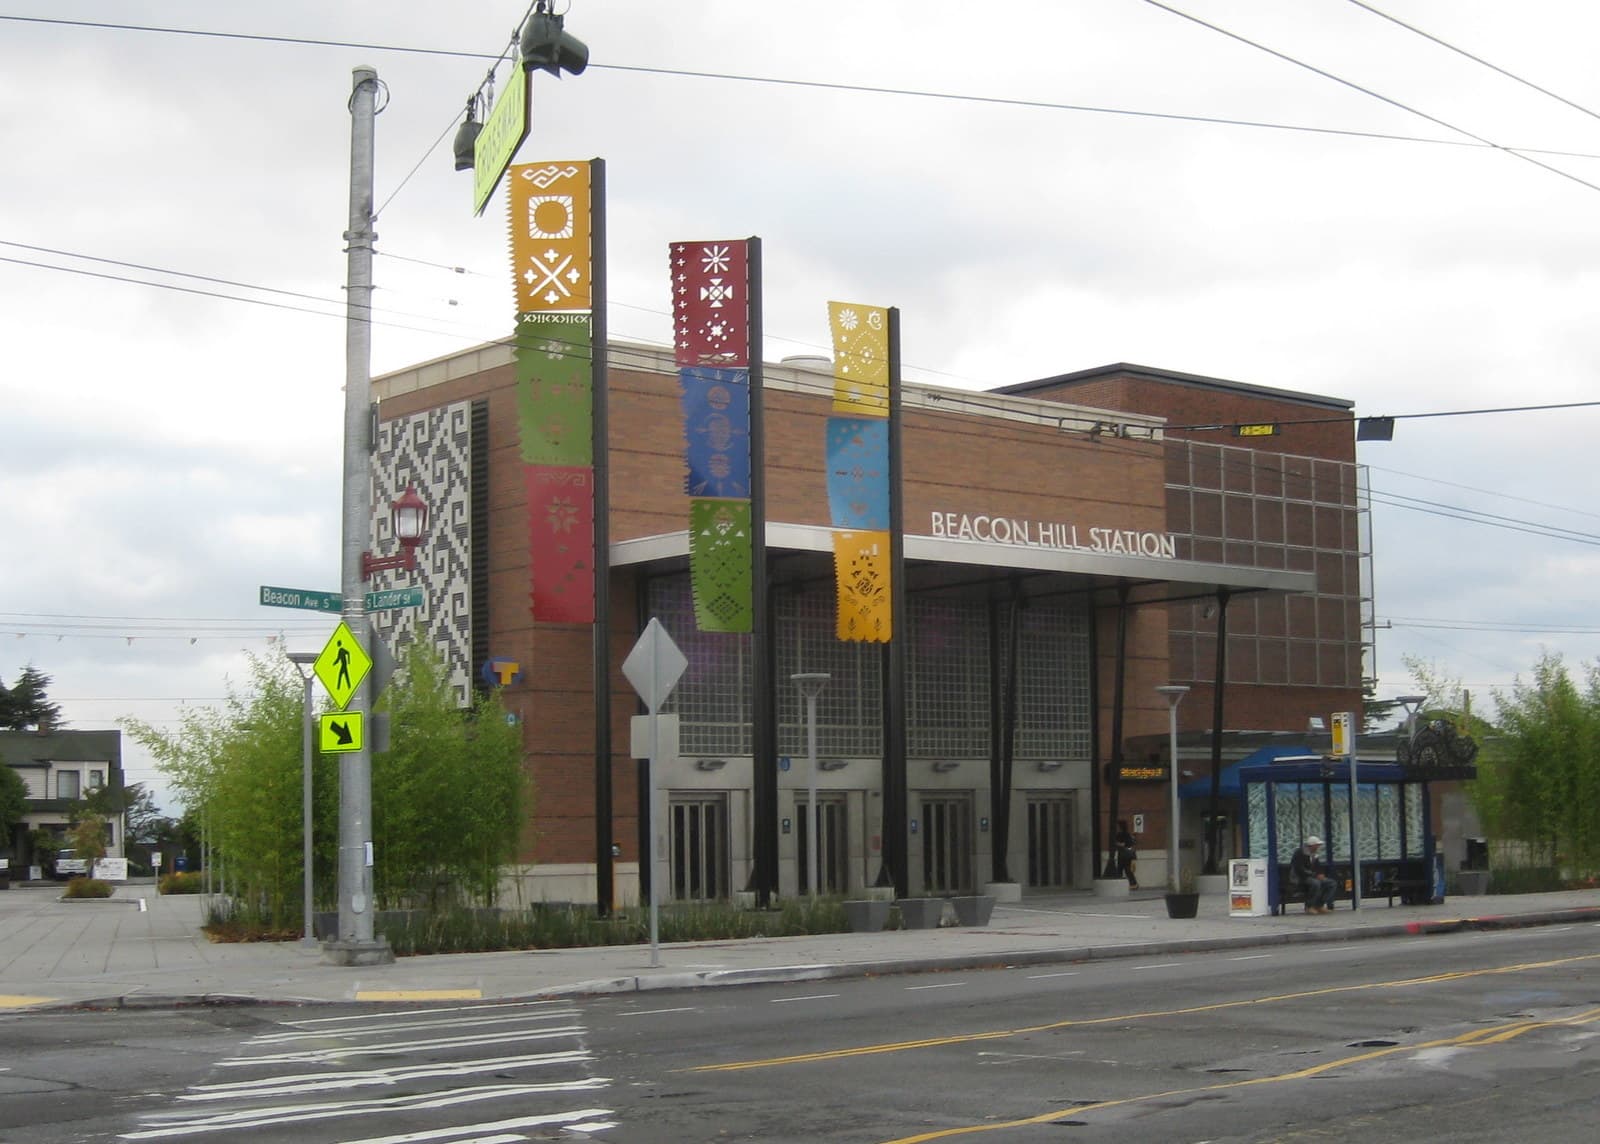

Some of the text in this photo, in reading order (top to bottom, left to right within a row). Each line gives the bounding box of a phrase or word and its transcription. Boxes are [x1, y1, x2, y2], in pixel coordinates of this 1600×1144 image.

[931, 511, 1177, 559] BEACON HILL STATION
[263, 588, 300, 606] Beacon
[323, 598, 330, 609] S
[373, 592, 401, 608] Lander
